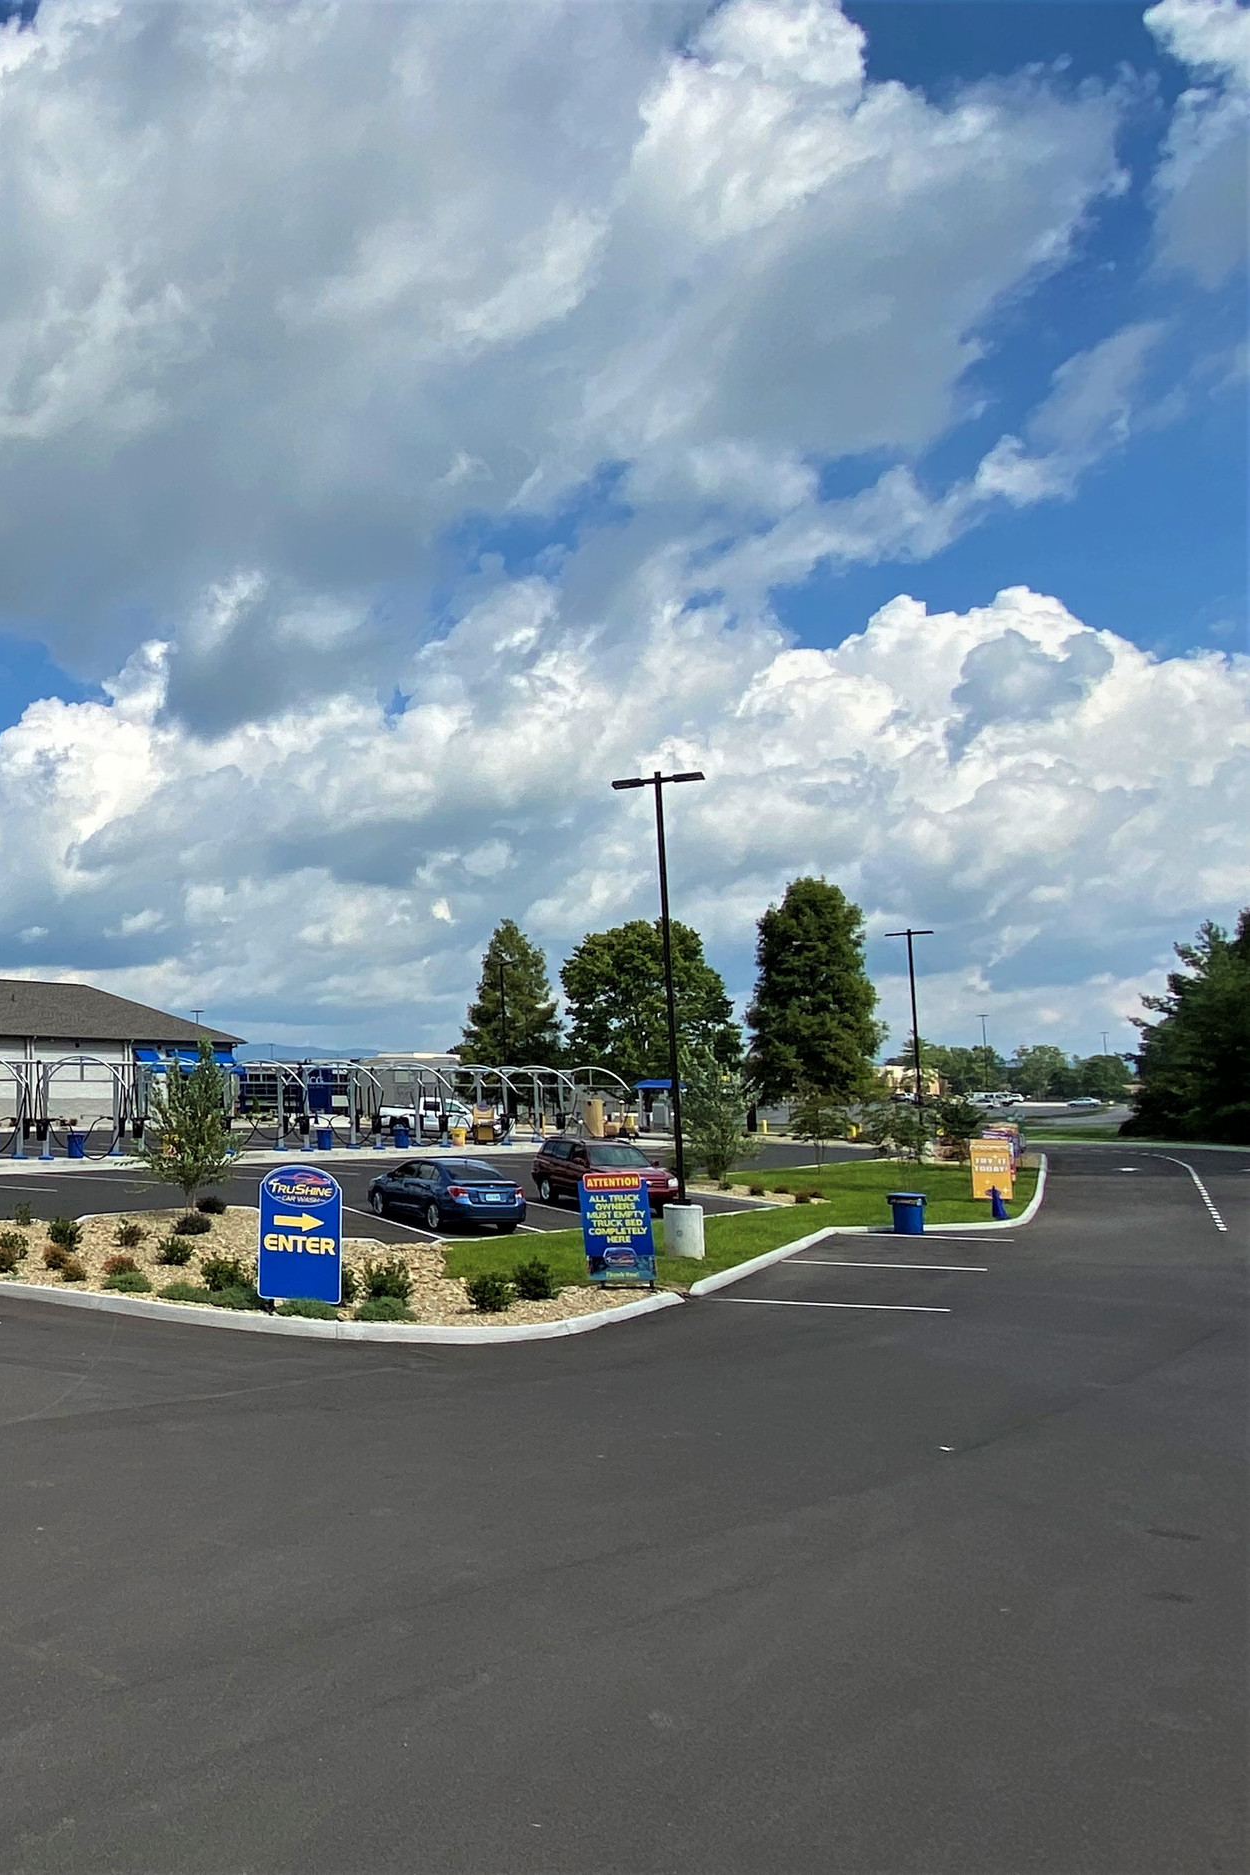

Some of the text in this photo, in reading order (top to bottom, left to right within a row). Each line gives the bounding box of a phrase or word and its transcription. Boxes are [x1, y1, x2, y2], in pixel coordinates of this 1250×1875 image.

[586, 1176, 639, 1188] ATTENTION
[297, 1195, 320, 1203] WASH
[588, 1193, 641, 1203] ALL TRUCK
[594, 1202, 636, 1211] OWNERS
[586, 1210, 646, 1219] MUST EMPTY
[591, 1219, 643, 1228] TRUCK BED
[588, 1226, 648, 1236] COMPLETELY
[606, 1235, 632, 1244] HERE
[263, 1233, 336, 1256] ENTER
